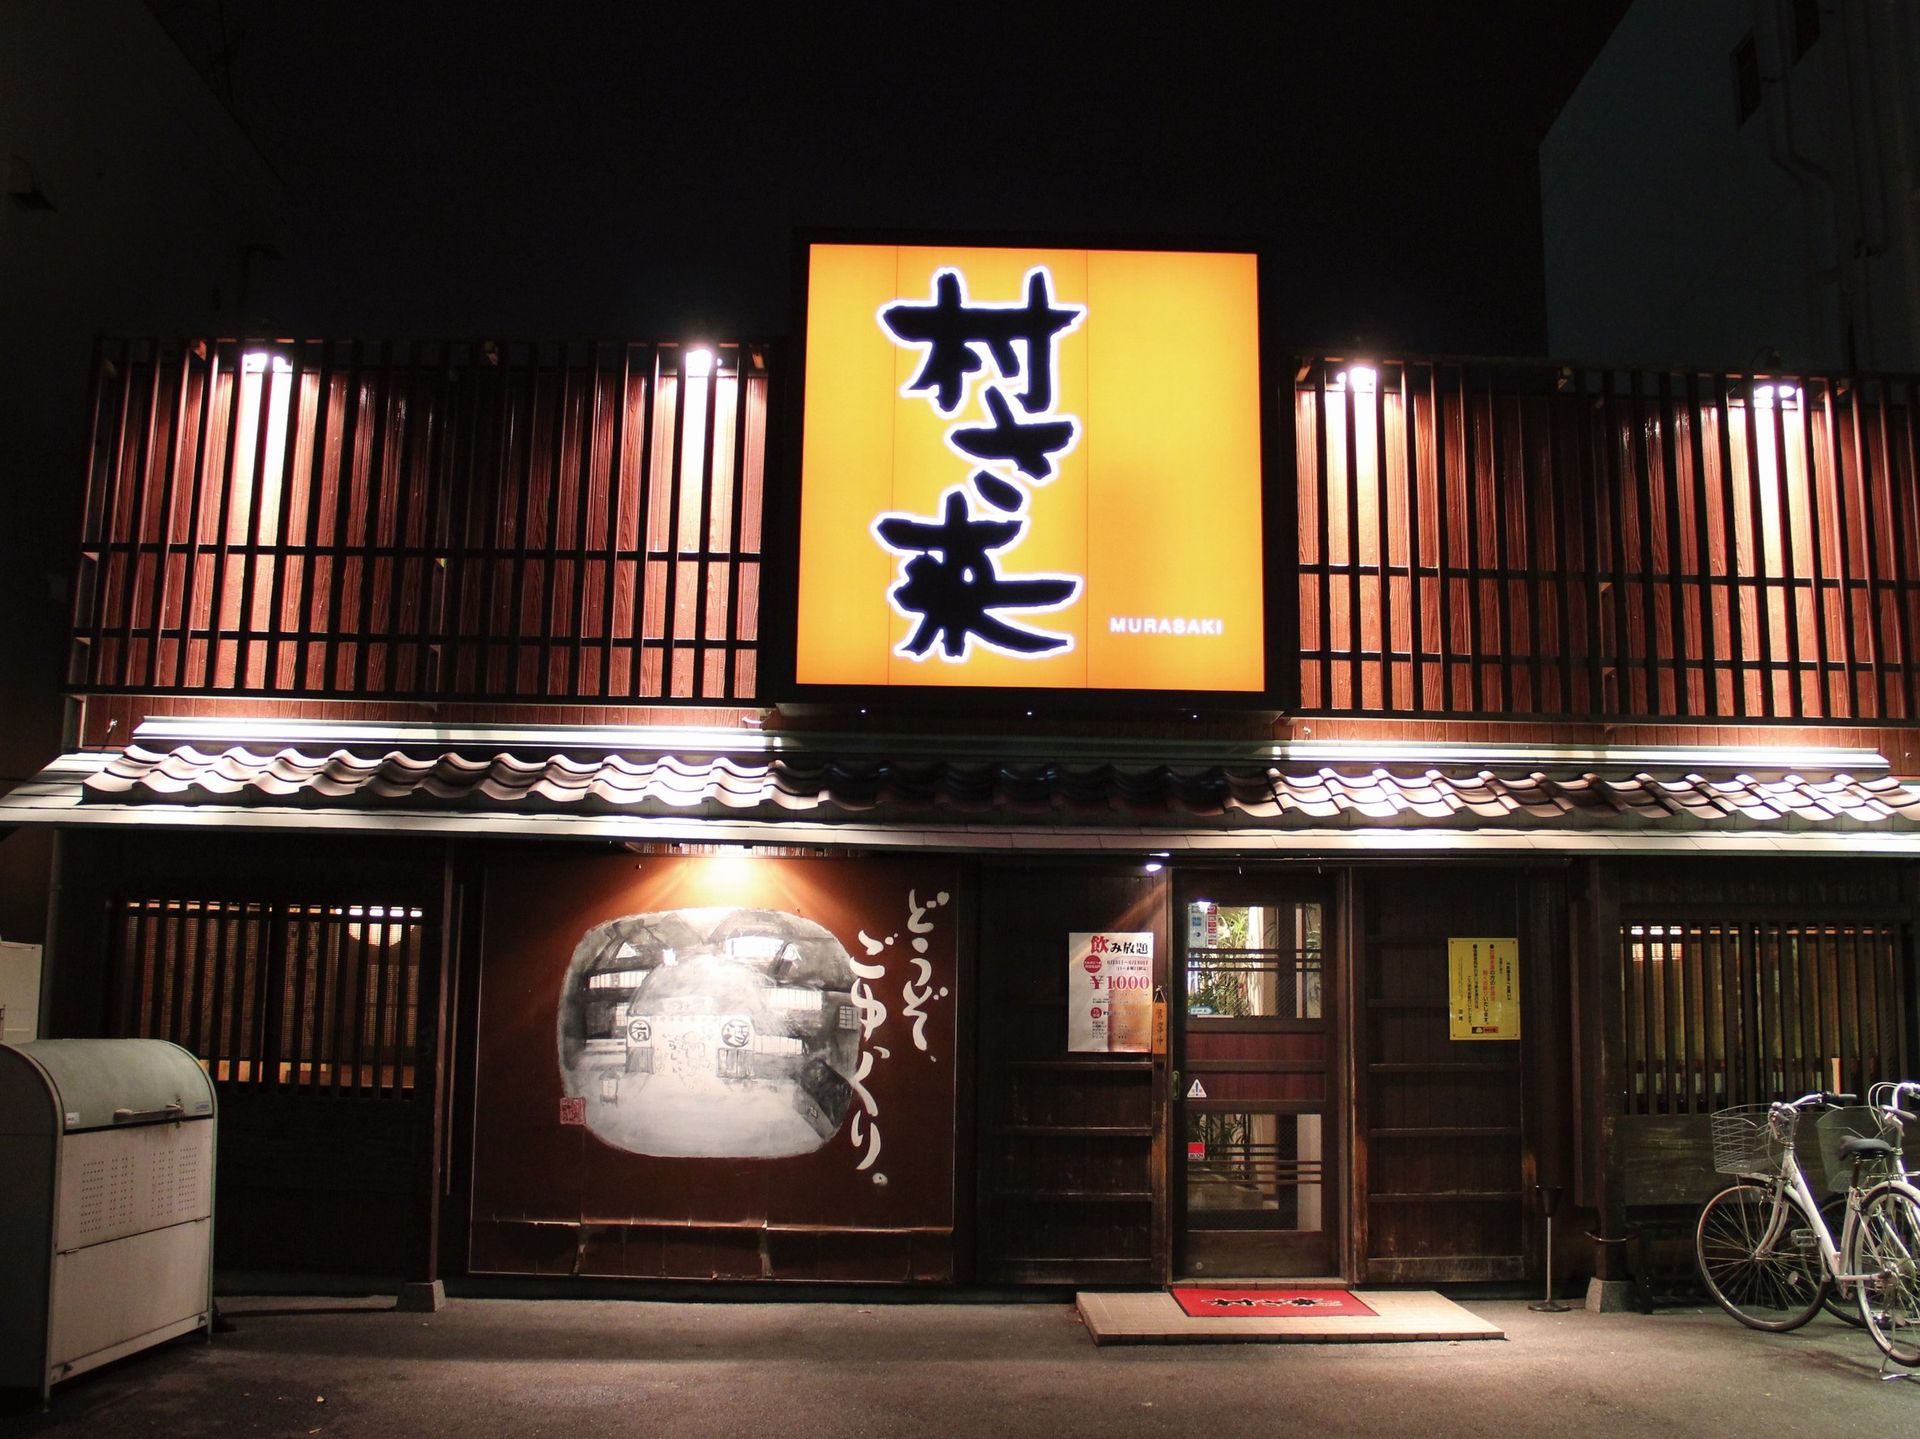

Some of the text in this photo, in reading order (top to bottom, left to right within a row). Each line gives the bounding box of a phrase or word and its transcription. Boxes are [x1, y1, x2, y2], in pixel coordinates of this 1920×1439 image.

[873, 267, 1087, 660] 村さ来
[1110, 617, 1222, 635] MURASAKI
[1091, 935, 1148, 955] 飲み放題
